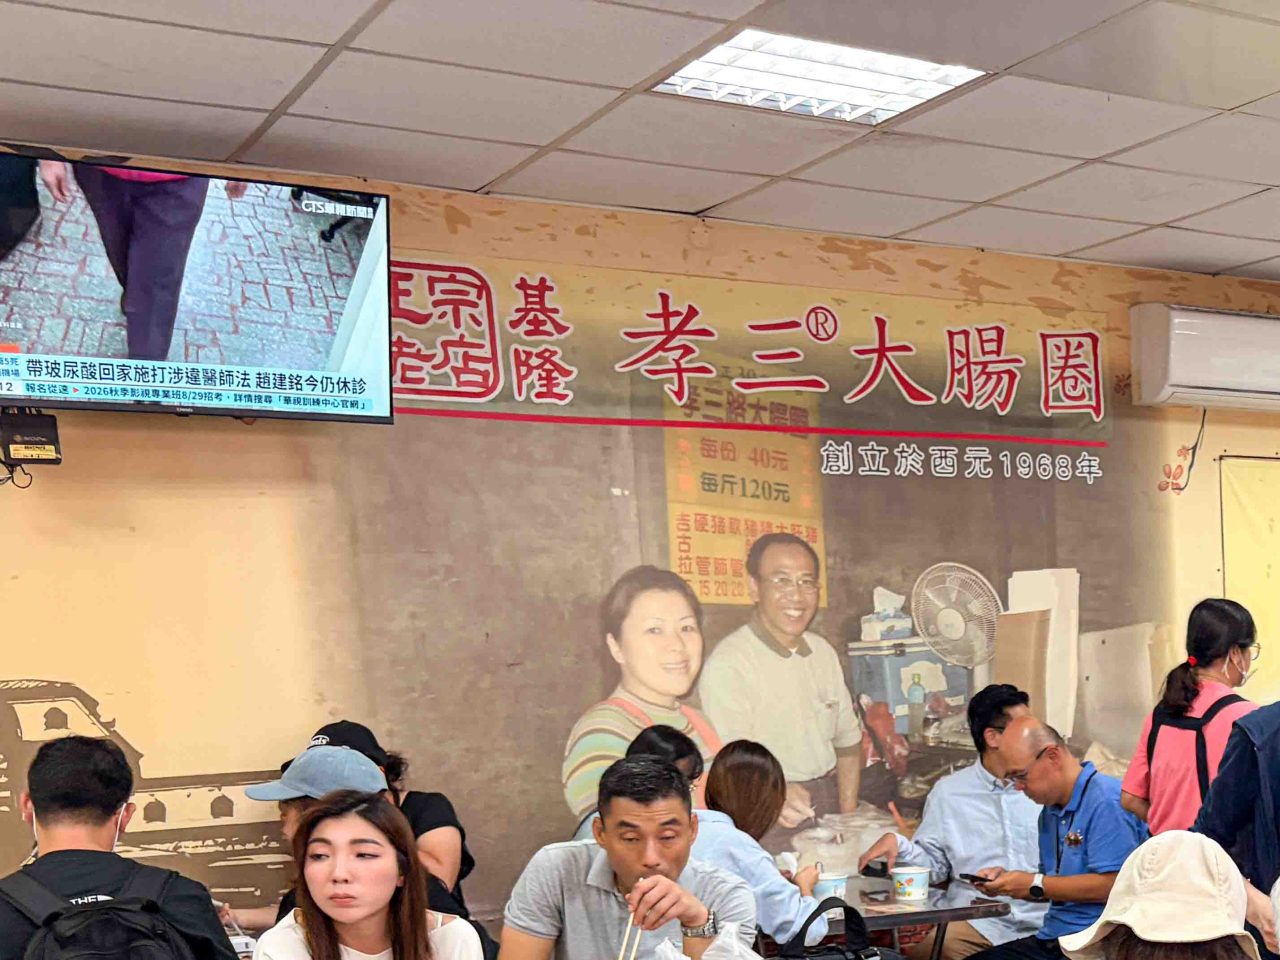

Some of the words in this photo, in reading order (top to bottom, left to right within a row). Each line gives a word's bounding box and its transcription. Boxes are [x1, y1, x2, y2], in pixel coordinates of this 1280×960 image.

[508, 276, 576, 403] 基隆
[255, 371, 367, 395] 趙建銘今仍休診
[821, 441, 1104, 484] 創立於西元1968年
[700, 471, 791, 503] 每斤120元
